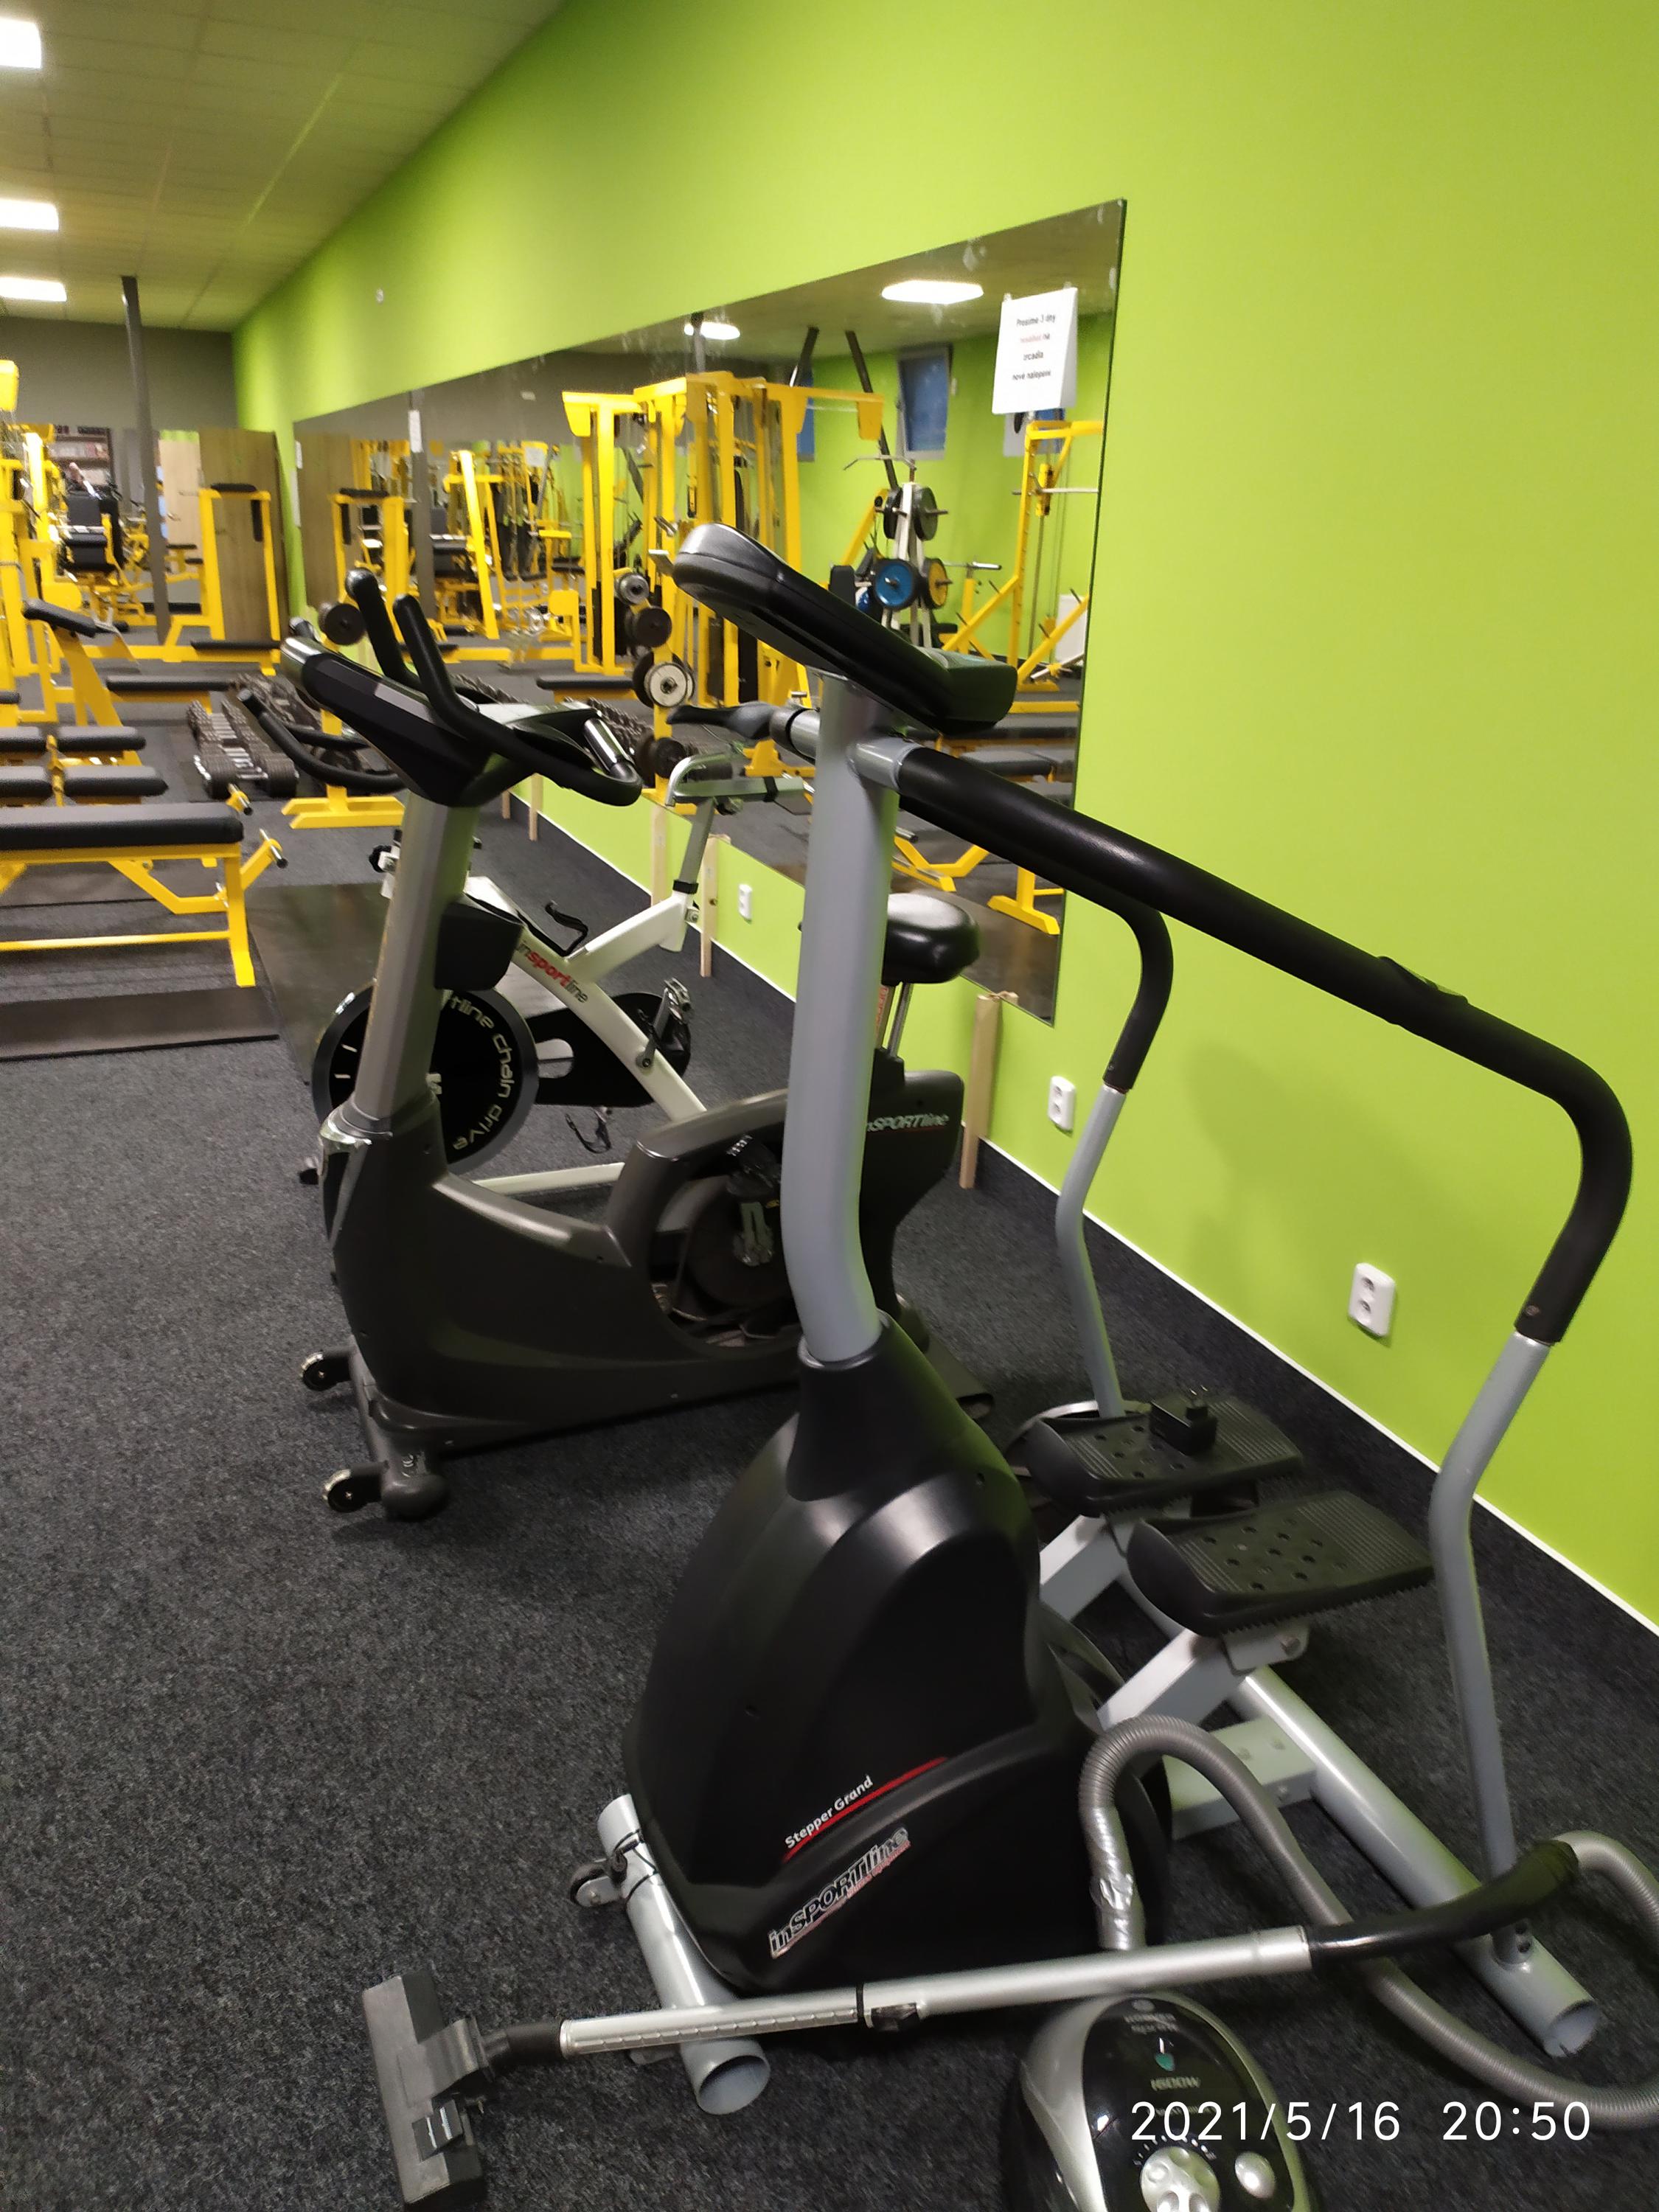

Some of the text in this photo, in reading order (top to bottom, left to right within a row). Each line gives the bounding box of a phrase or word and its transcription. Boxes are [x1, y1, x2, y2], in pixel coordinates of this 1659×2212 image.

[492, 1033, 515, 1099] chain
[453, 1104, 503, 1150] drive
[785, 1774, 874, 1848] Stepper Grand
[768, 1826, 909, 1957] inSPORTline
